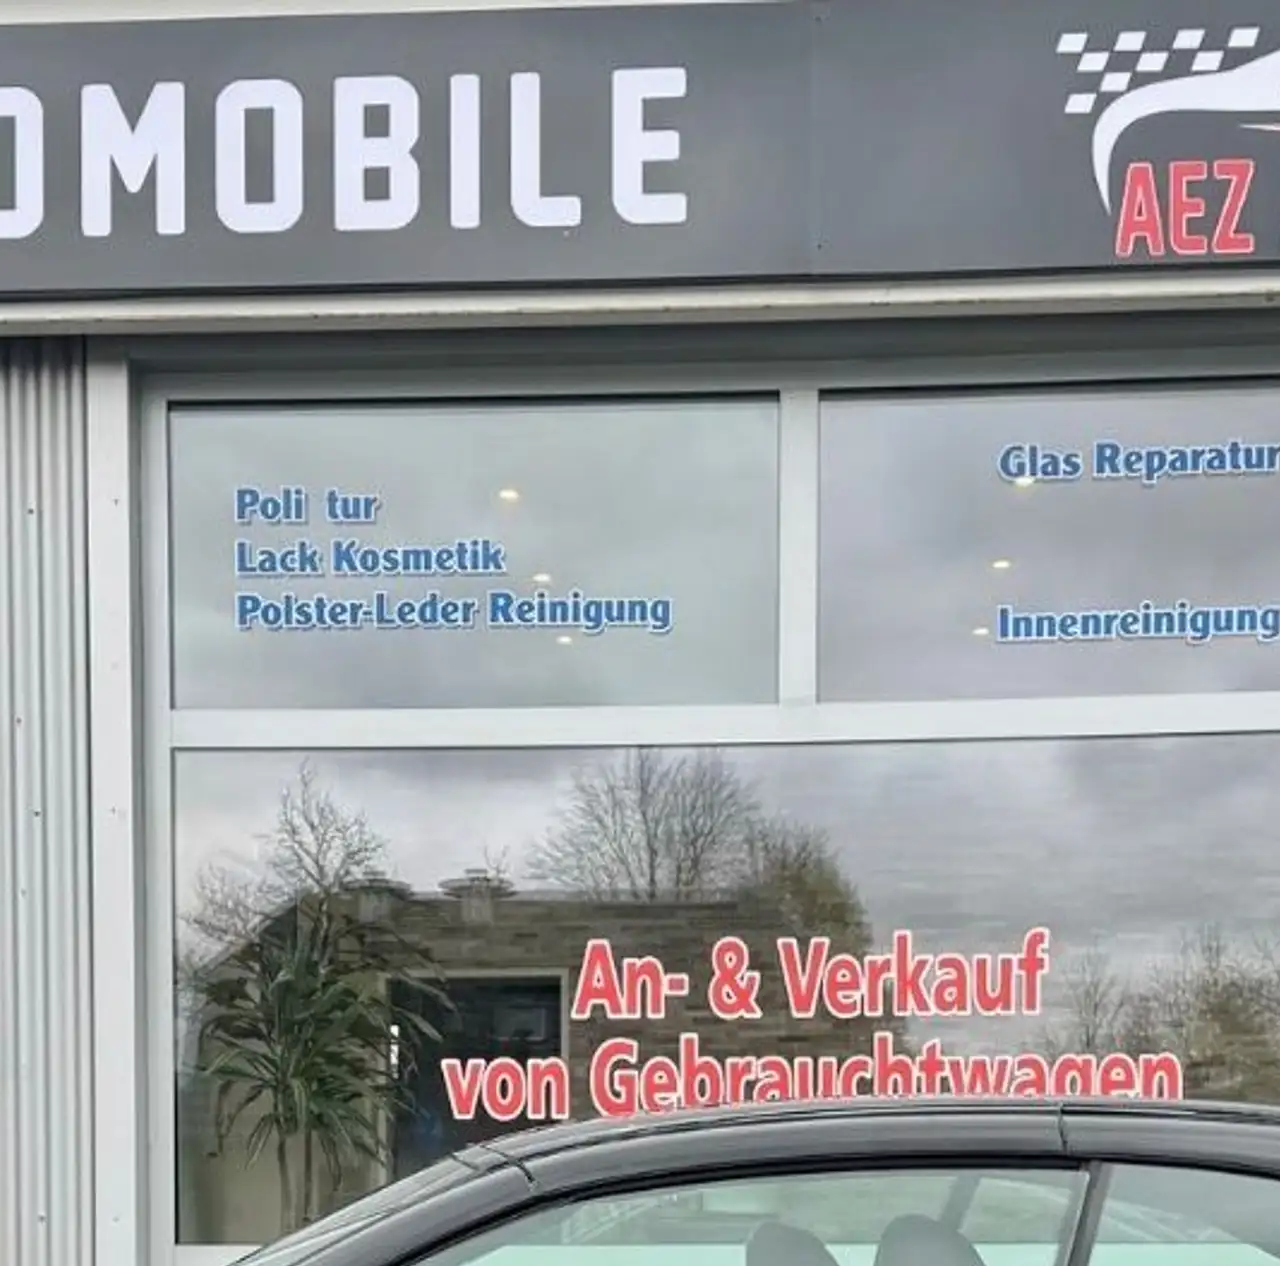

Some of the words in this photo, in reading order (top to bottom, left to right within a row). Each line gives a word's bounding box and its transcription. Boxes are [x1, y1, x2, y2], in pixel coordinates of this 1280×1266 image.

[1115, 158, 1255, 256] AEZ
[997, 444, 1084, 480] Glas
[234, 539, 323, 575] Lack
[331, 537, 508, 575] Kosmetik
[234, 591, 480, 629] Polster-Leder
[486, 590, 674, 636] Reinigung
[570, 937, 690, 1019] An-
[707, 935, 762, 1018] &
[778, 926, 1051, 1018] Verkauf
[441, 1056, 569, 1121] von
[590, 1032, 1183, 1120] Gebrauchtwagen
